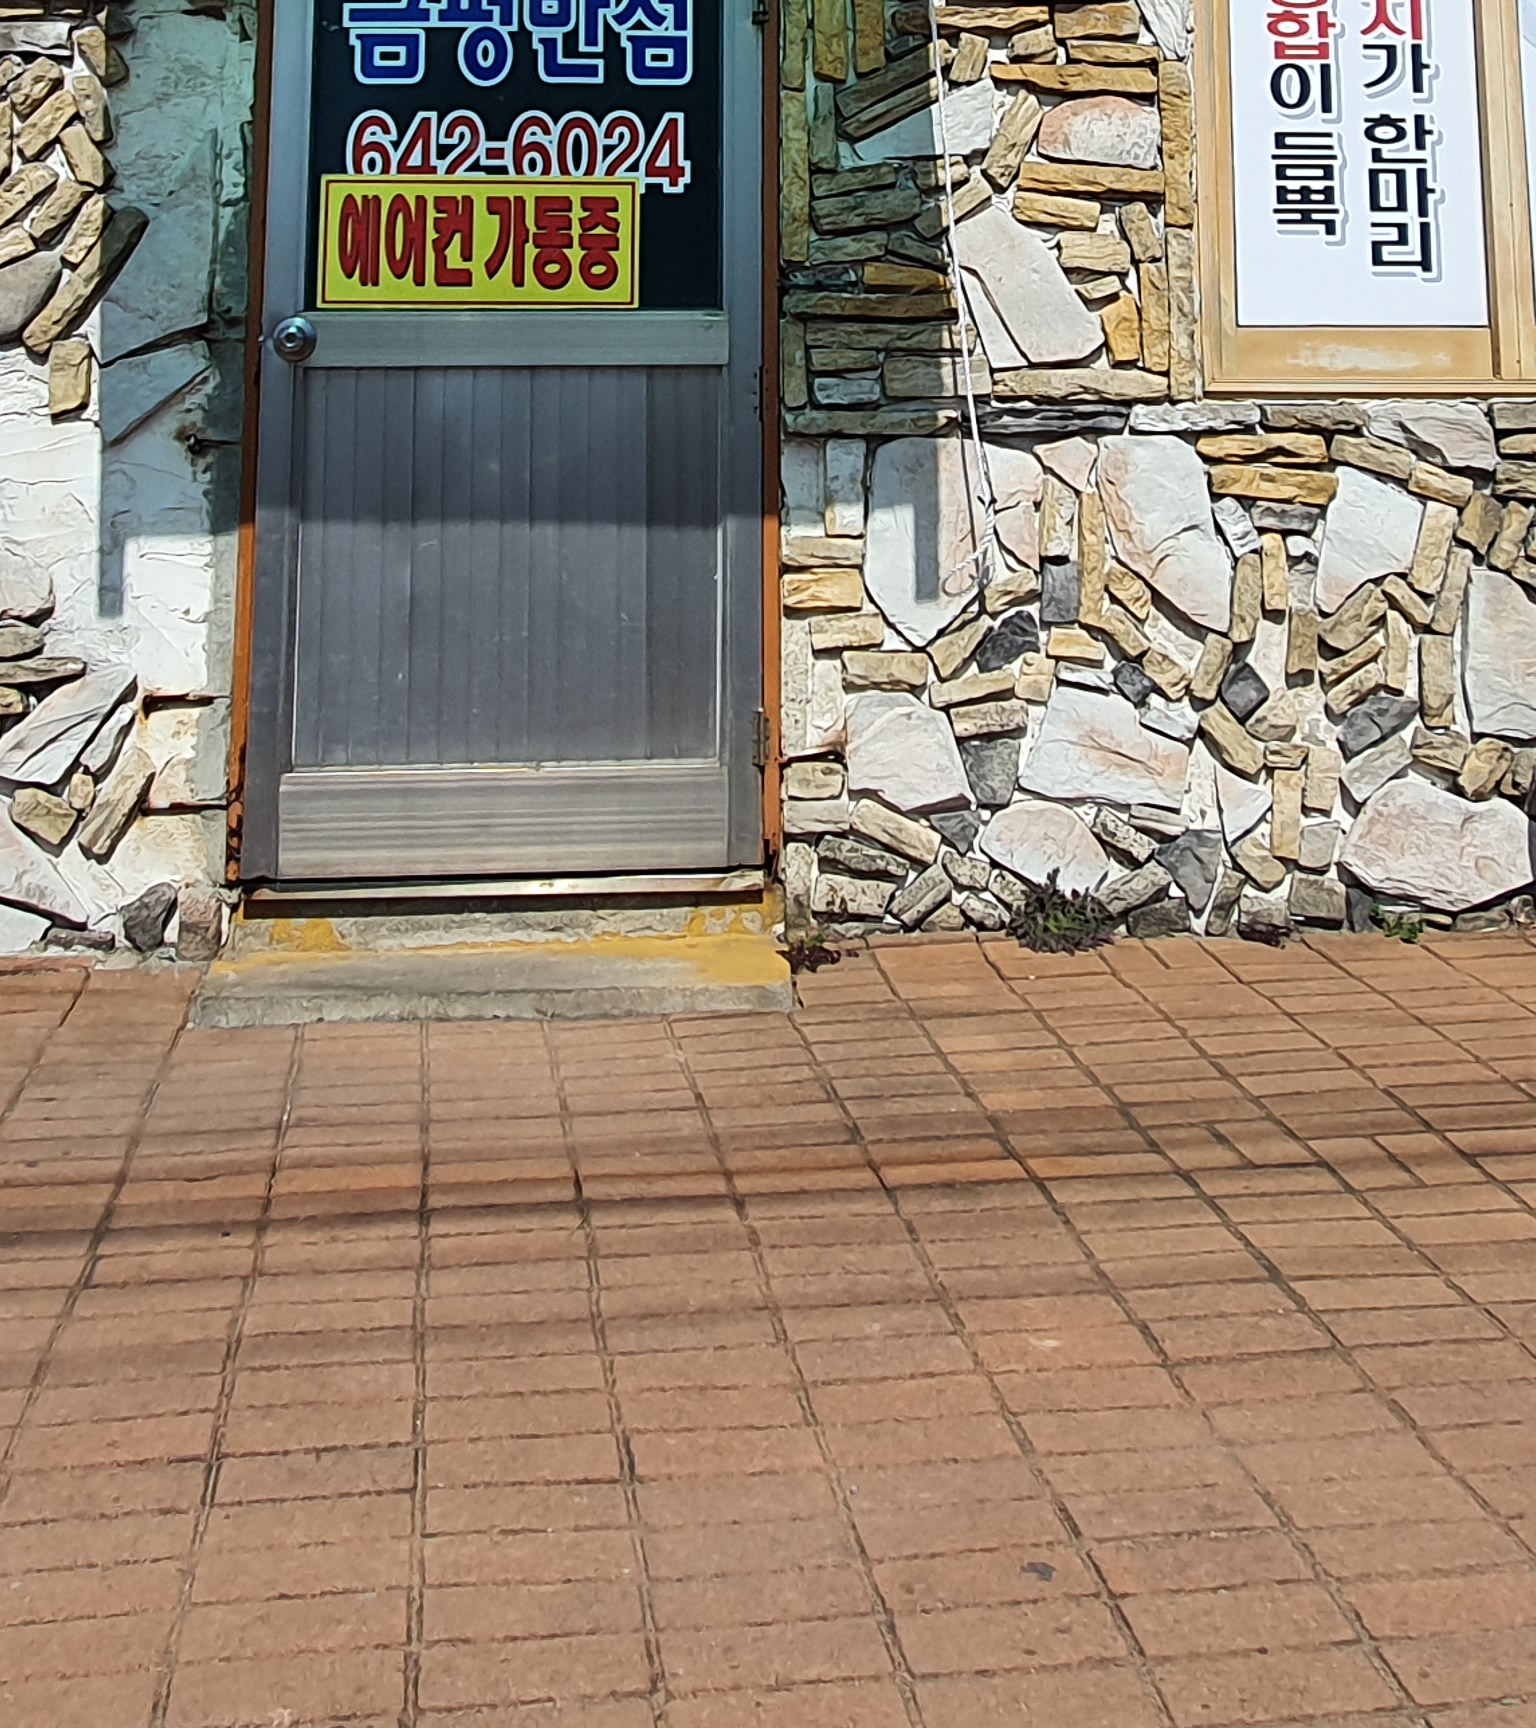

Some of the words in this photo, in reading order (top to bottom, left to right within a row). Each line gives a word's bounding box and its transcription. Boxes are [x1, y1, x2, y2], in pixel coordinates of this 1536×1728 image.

[344, 109, 692, 194] 642-6024
[1270, 130, 1341, 237] 듬뿍
[1361, 112, 1436, 274] 한마리
[337, 192, 474, 287] 에어컨
[485, 194, 621, 290] 가동중
